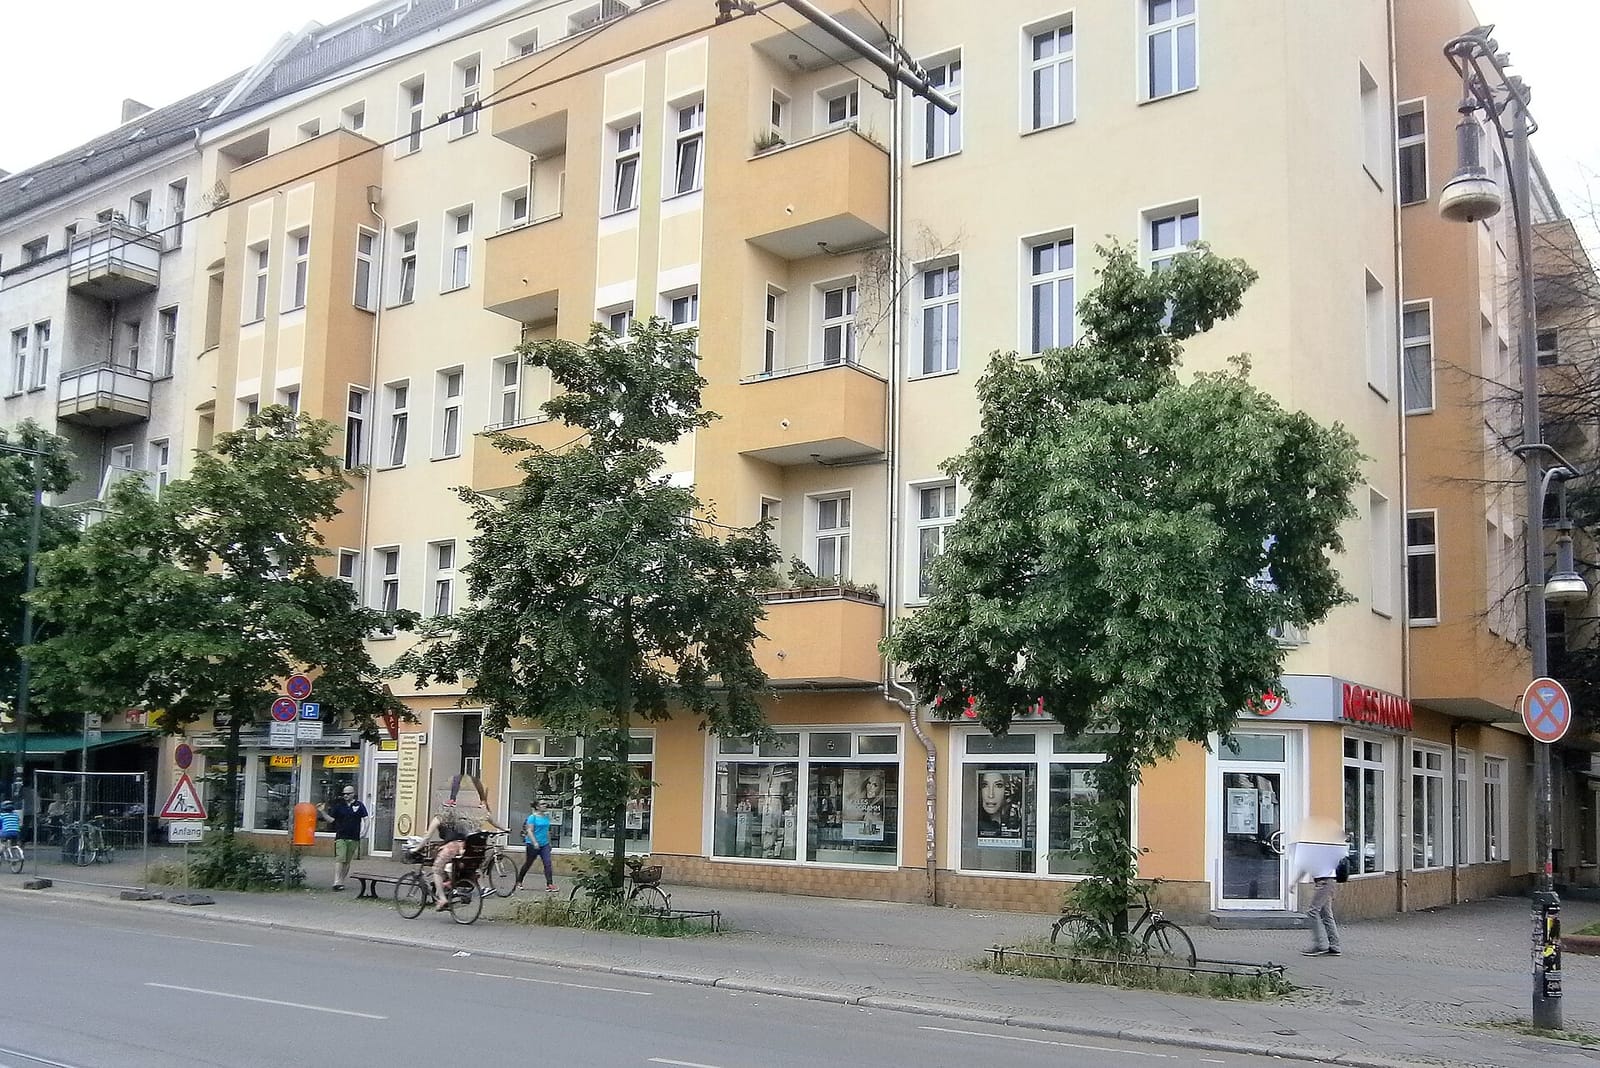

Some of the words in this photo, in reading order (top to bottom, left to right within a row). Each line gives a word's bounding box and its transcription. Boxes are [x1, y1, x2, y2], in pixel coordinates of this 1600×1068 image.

[304, 705, 314, 717] P
[1343, 683, 1413, 730] ROSSMANN
[336, 755, 355, 764] LOTTO
[172, 827, 201, 837] Anfang
